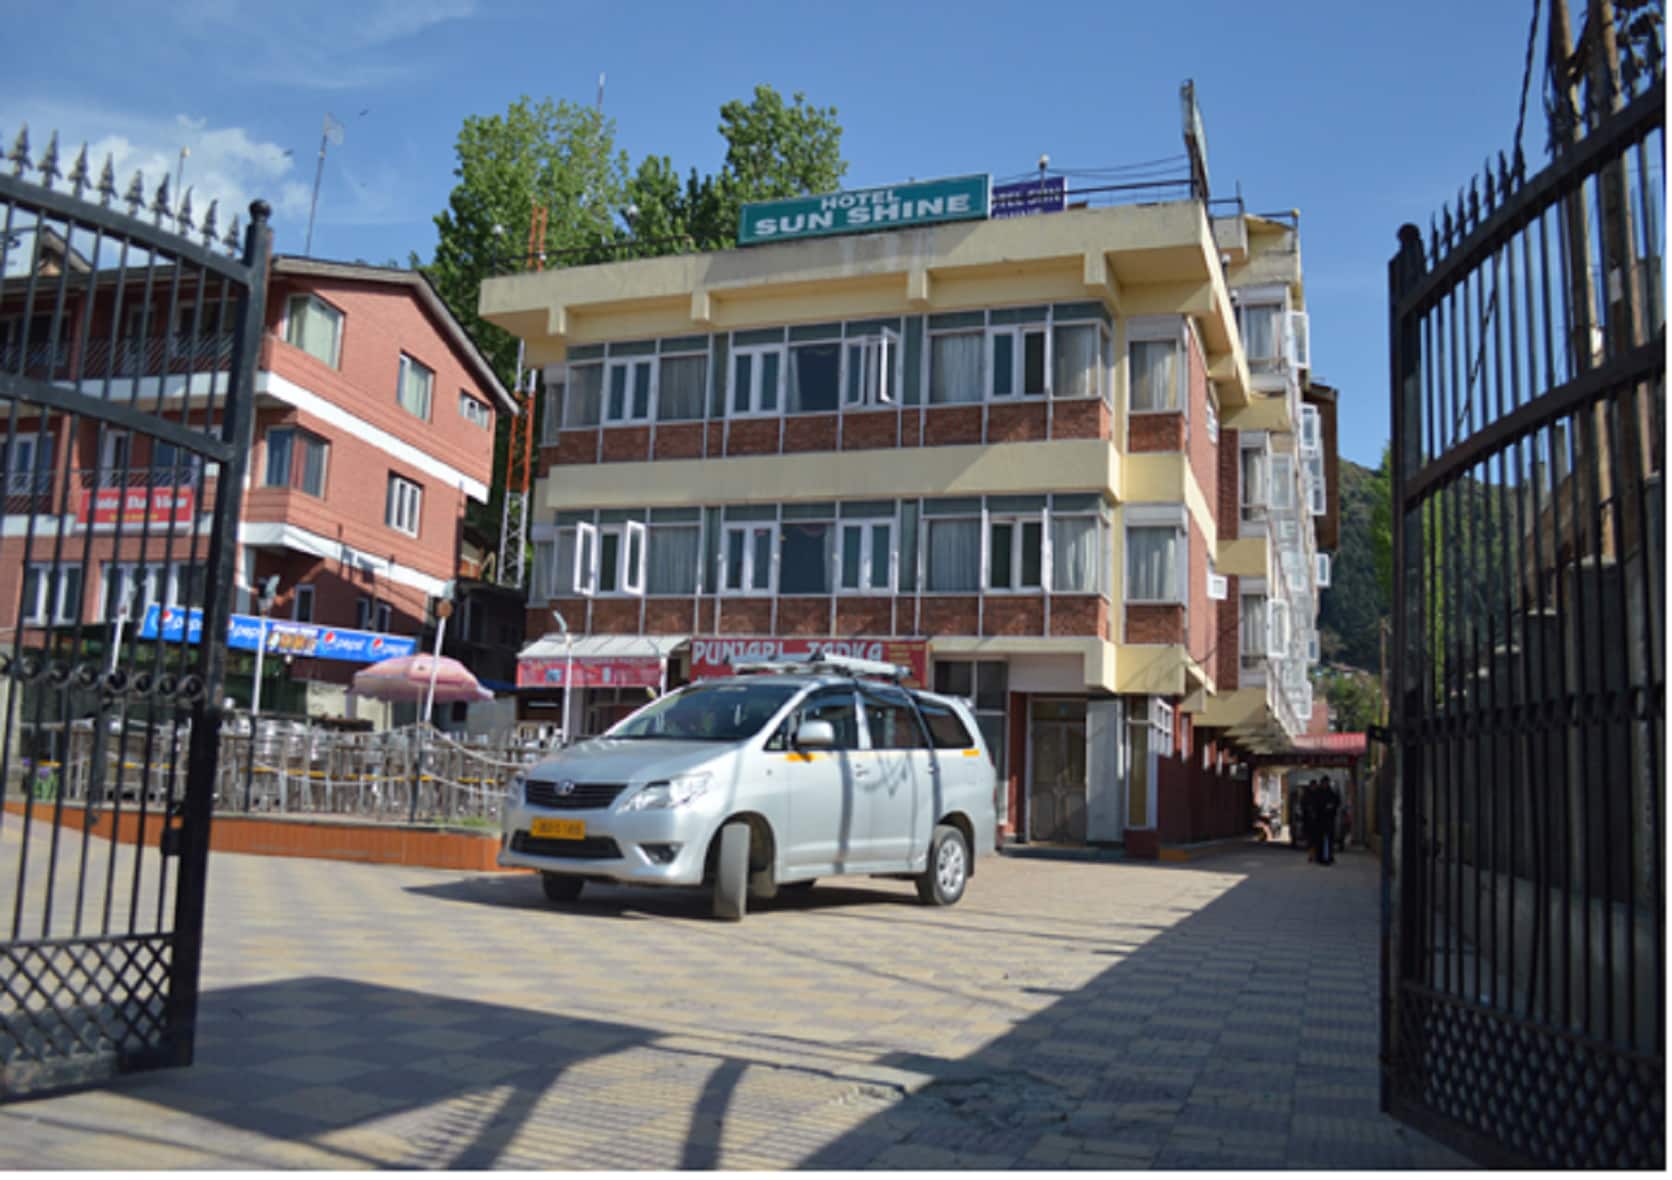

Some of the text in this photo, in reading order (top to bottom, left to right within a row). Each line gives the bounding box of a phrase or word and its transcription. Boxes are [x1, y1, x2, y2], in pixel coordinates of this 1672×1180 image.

[754, 194, 971, 235] SUN SHINE
[821, 189, 897, 211] HOTEL
